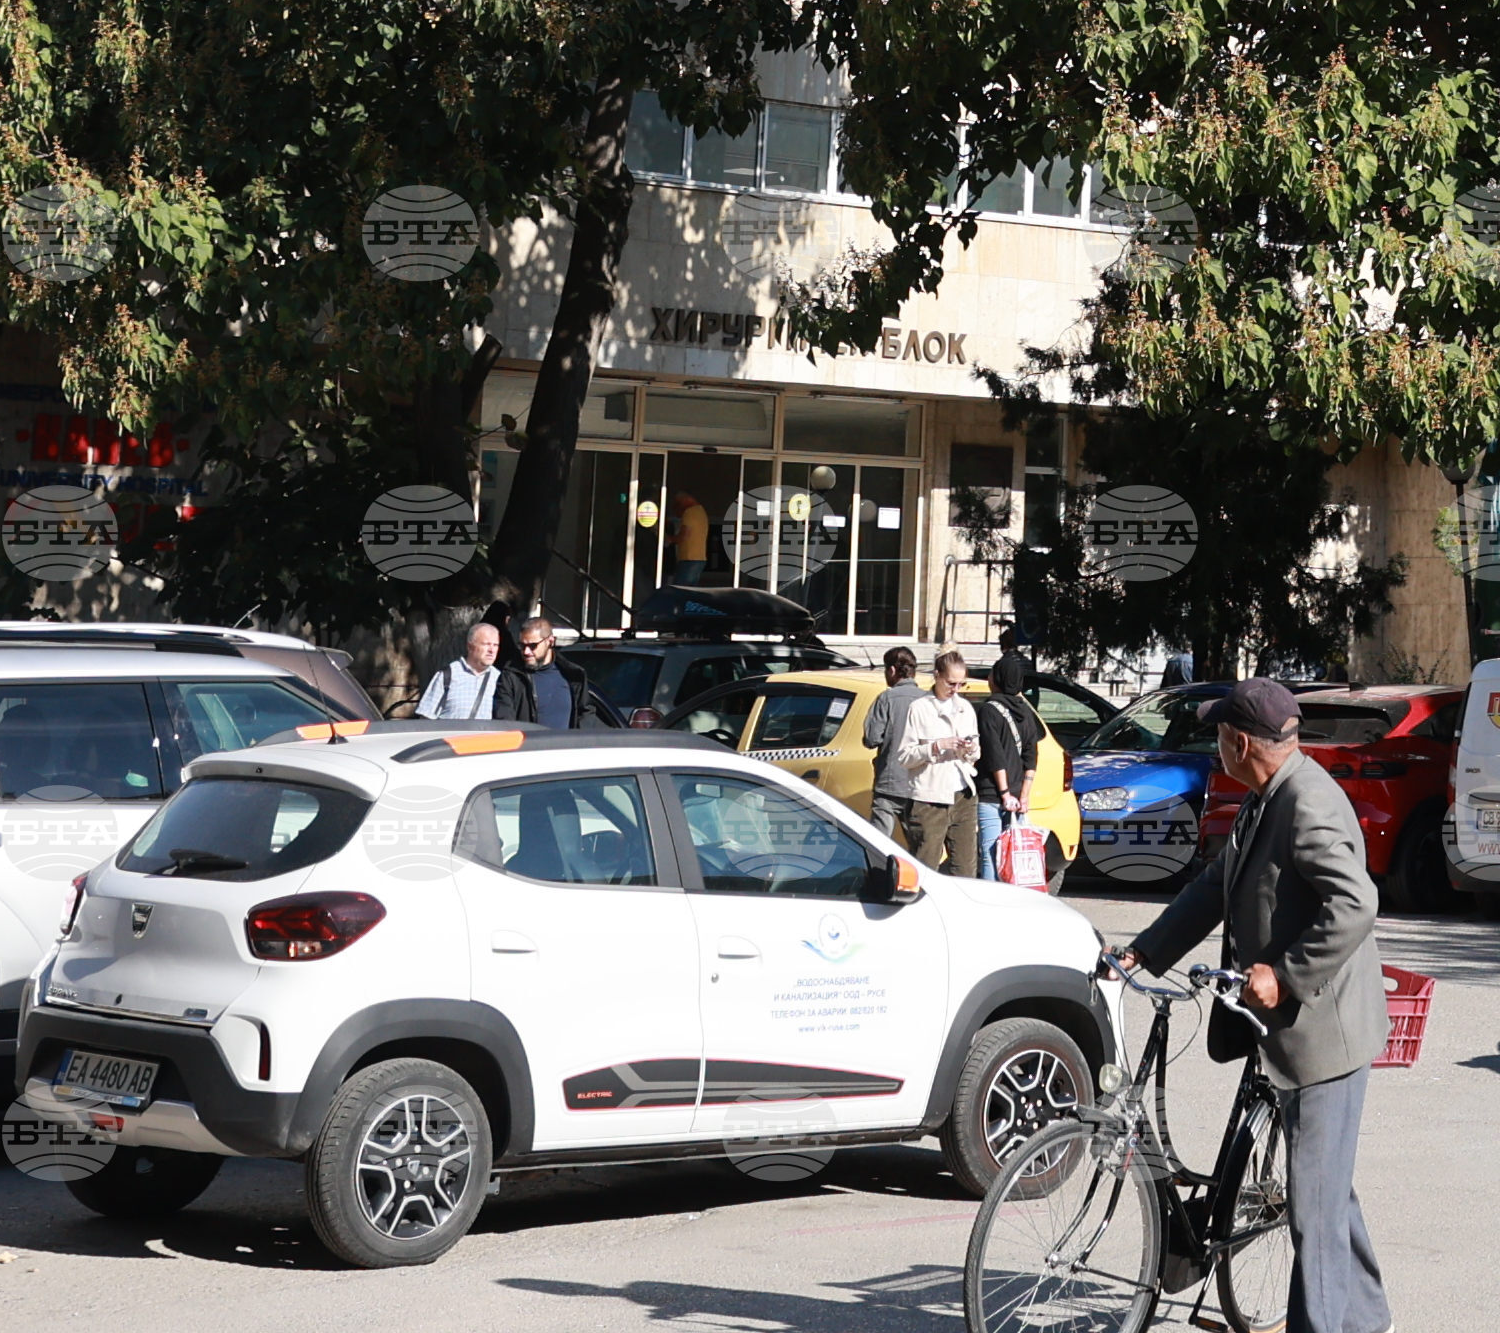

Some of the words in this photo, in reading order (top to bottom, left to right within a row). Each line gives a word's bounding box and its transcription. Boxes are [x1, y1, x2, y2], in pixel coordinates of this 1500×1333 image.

[883, 327, 967, 364] БЛОК
[1483, 811, 1495, 825] CB
[867, 989, 886, 998] РУСЕ
[66, 1056, 90, 1084] EA
[90, 1059, 130, 1089] 4480
[127, 1065, 153, 1093] AB
